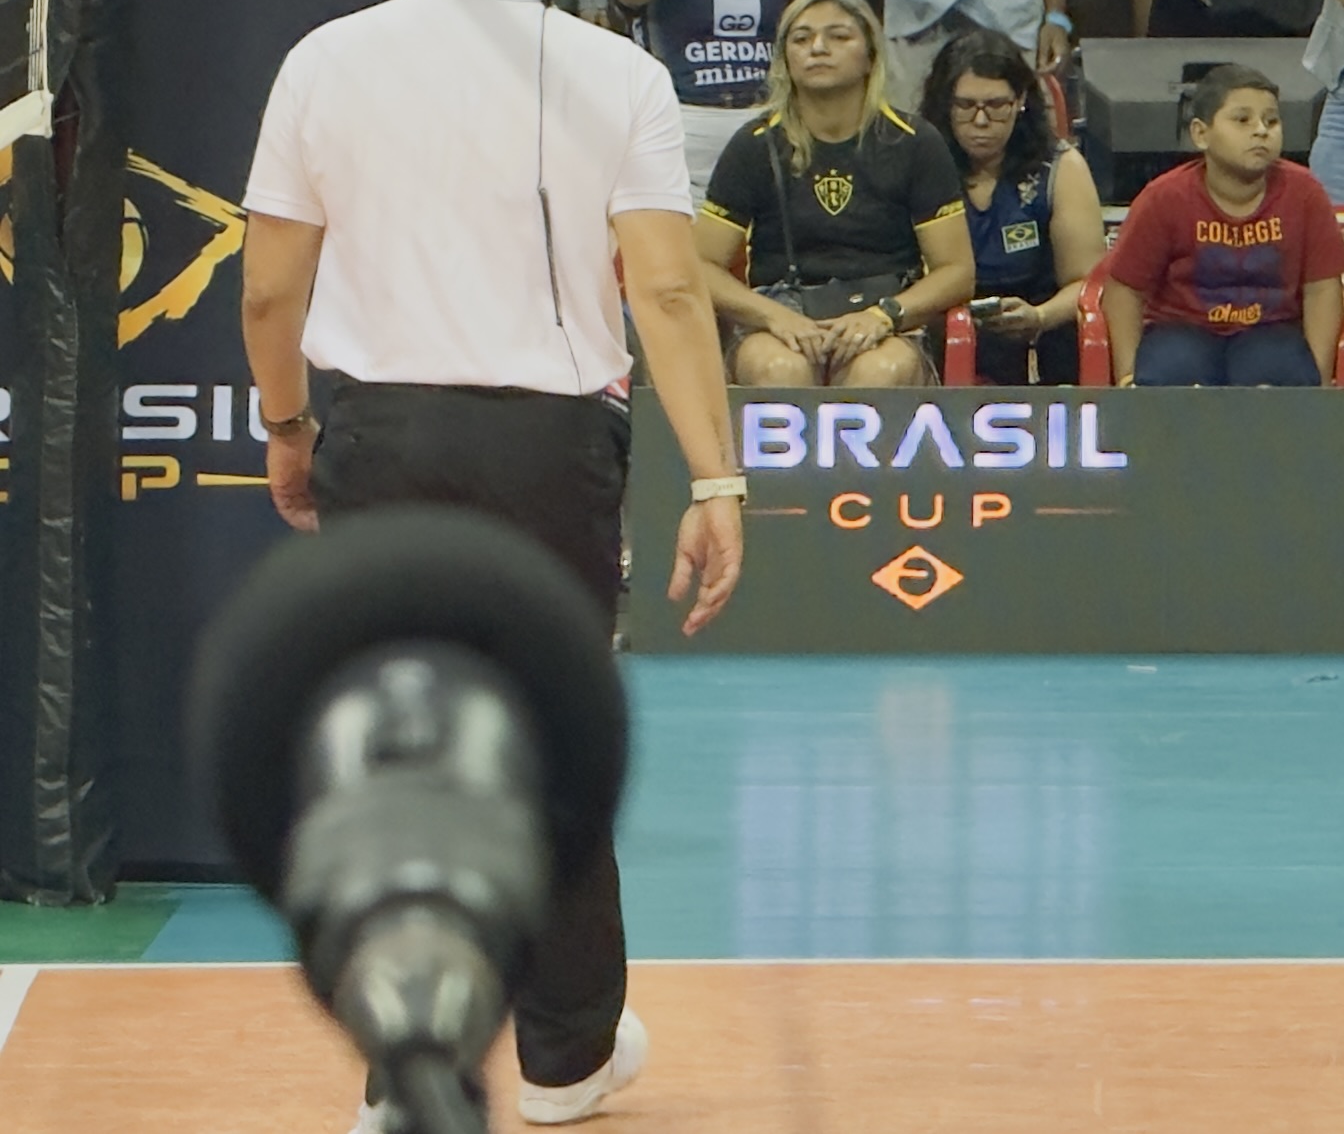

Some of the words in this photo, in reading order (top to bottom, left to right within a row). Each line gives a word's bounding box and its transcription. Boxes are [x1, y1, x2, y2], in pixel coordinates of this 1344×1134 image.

[694, 64, 767, 87] mina
[1196, 217, 1283, 248] COLLEGE
[743, 402, 1128, 468] BRASIL
[829, 492, 1012, 529] CUP
